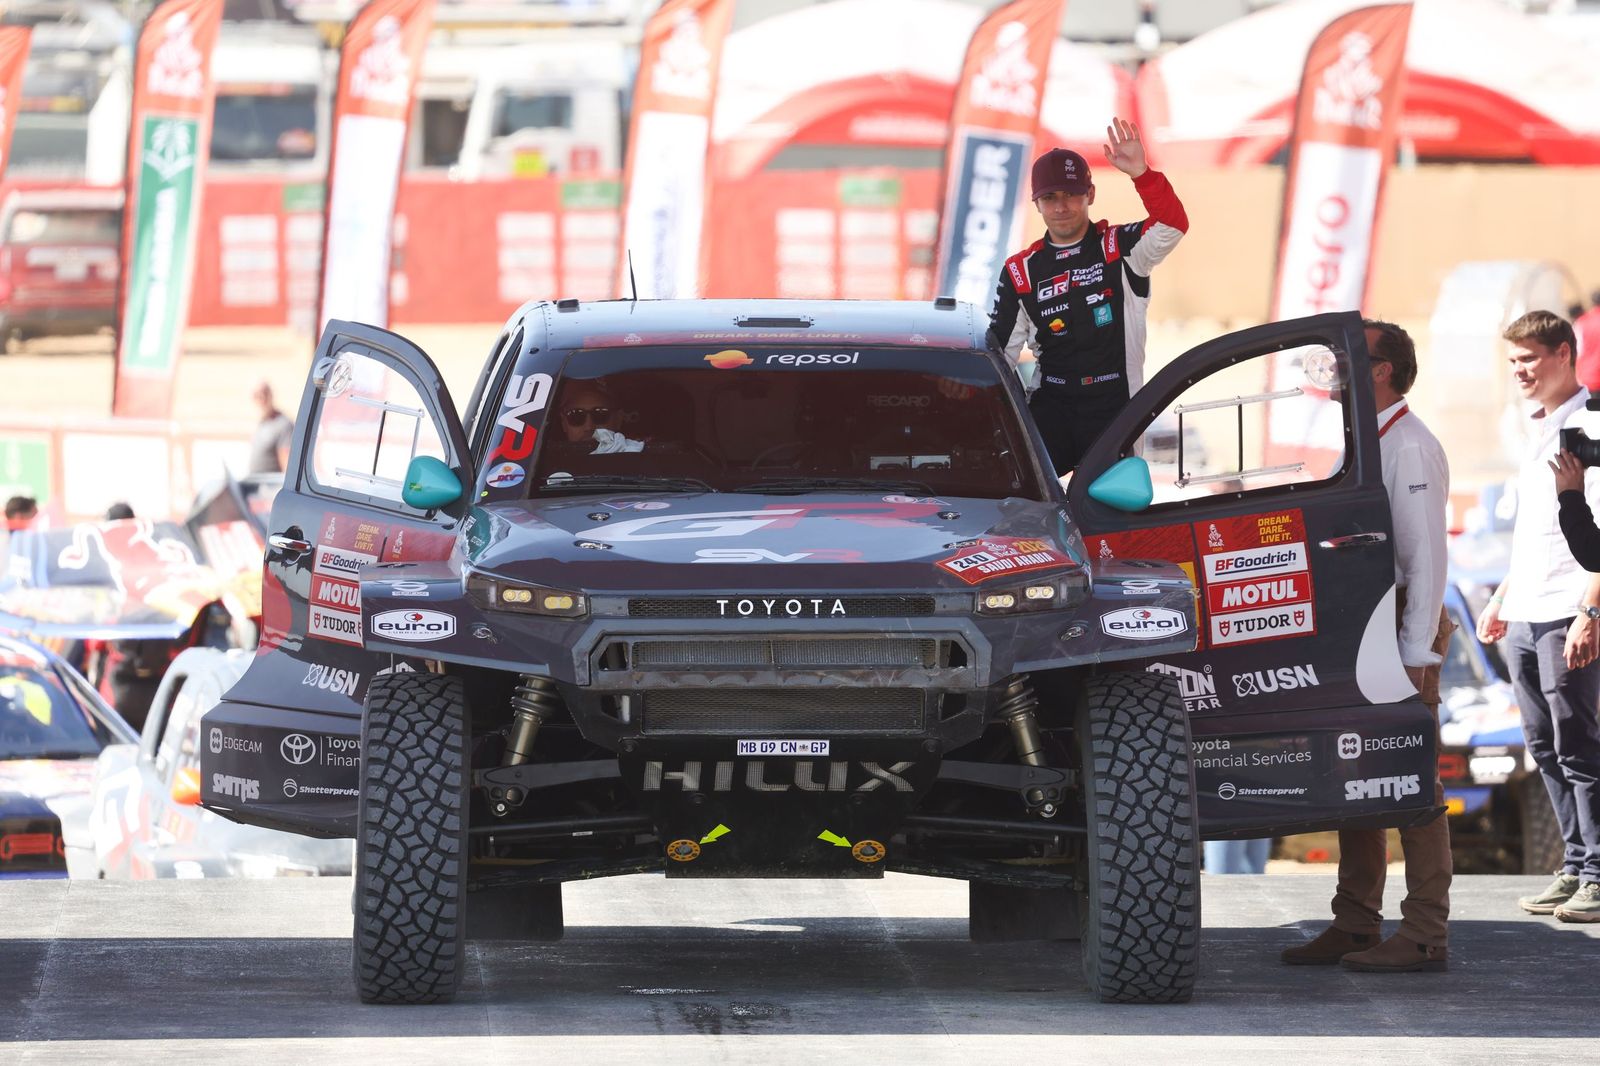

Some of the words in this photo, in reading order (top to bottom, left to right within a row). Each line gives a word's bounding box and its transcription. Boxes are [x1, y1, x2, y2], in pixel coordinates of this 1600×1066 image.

[1039, 280, 1068, 301] GR
[1086, 288, 1114, 305] SVR
[1041, 303, 1070, 318] HILUX
[766, 351, 860, 367] repsol
[867, 395, 932, 407] RECARO
[487, 372, 554, 465] SVR
[575, 503, 943, 542] GR
[1258, 515, 1292, 527] DREAM.
[1260, 525, 1286, 535] DARE.
[1261, 533, 1280, 544] LIVE
[1281, 532, 1292, 541] IT.
[691, 548, 866, 564] SVR
[953, 554, 989, 569] 240
[977, 558, 1017, 574] SAUDI
[1015, 551, 1056, 567] ARABIA
[1215, 550, 1297, 571] BFGoodrich
[1222, 579, 1298, 608] MOTUL
[716, 599, 847, 615] TOYOTA
[322, 615, 356, 634] TUDOR
[378, 620, 449, 631] eurol
[1108, 617, 1180, 630] eurol
[1233, 614, 1291, 634] TUDOR
[318, 666, 360, 697] USN
[1254, 664, 1320, 693] USN
[1184, 698, 1222, 712] EAR
[223, 736, 262, 754] EDGECAM
[325, 736, 361, 752] Toyot
[740, 741, 757, 753] MB
[760, 741, 776, 753] 09
[780, 741, 797, 753] CN
[811, 741, 827, 753] GP
[1192, 739, 1231, 754] oyota
[1364, 734, 1423, 752] EDGECAM
[327, 752, 361, 767] Finan
[1193, 753, 1248, 768] nancial
[1252, 750, 1312, 766] Services
[643, 761, 917, 792] HILUX
[213, 772, 260, 803] SMITHS
[1238, 787, 1305, 796] Shatterprufe
[1344, 774, 1421, 802] SMITHS
